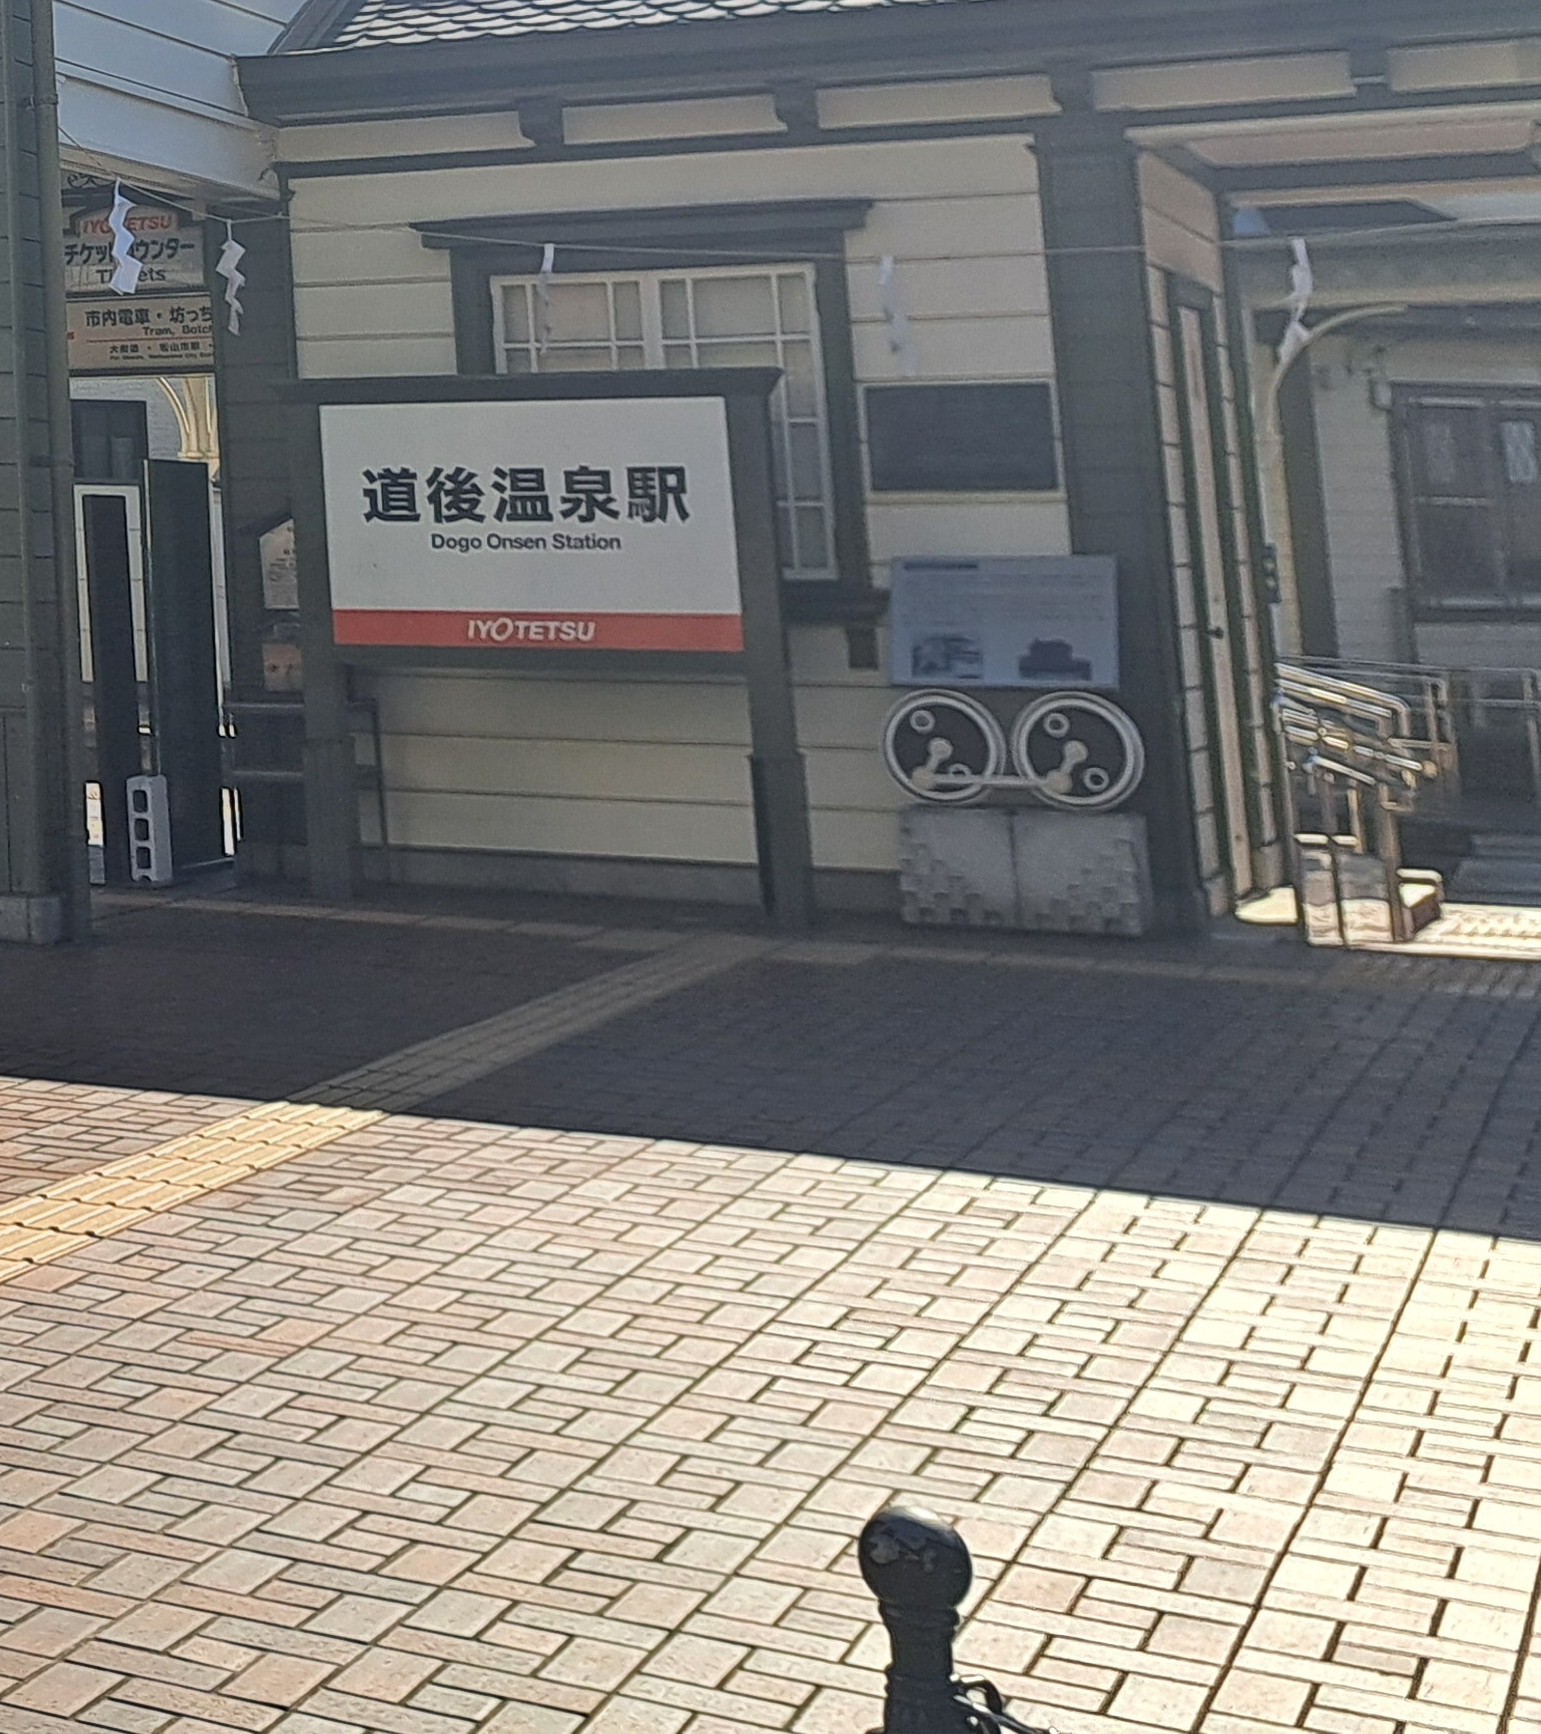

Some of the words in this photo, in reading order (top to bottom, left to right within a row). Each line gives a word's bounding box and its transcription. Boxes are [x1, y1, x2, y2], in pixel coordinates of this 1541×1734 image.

[83, 216, 173, 235] IYOETSU
[362, 465, 690, 523] 道後温泉駅
[431, 533, 482, 552] Dogo
[487, 533, 546, 550] Onsen
[552, 533, 622, 550] Station
[468, 618, 595, 642] IYOTETSU
